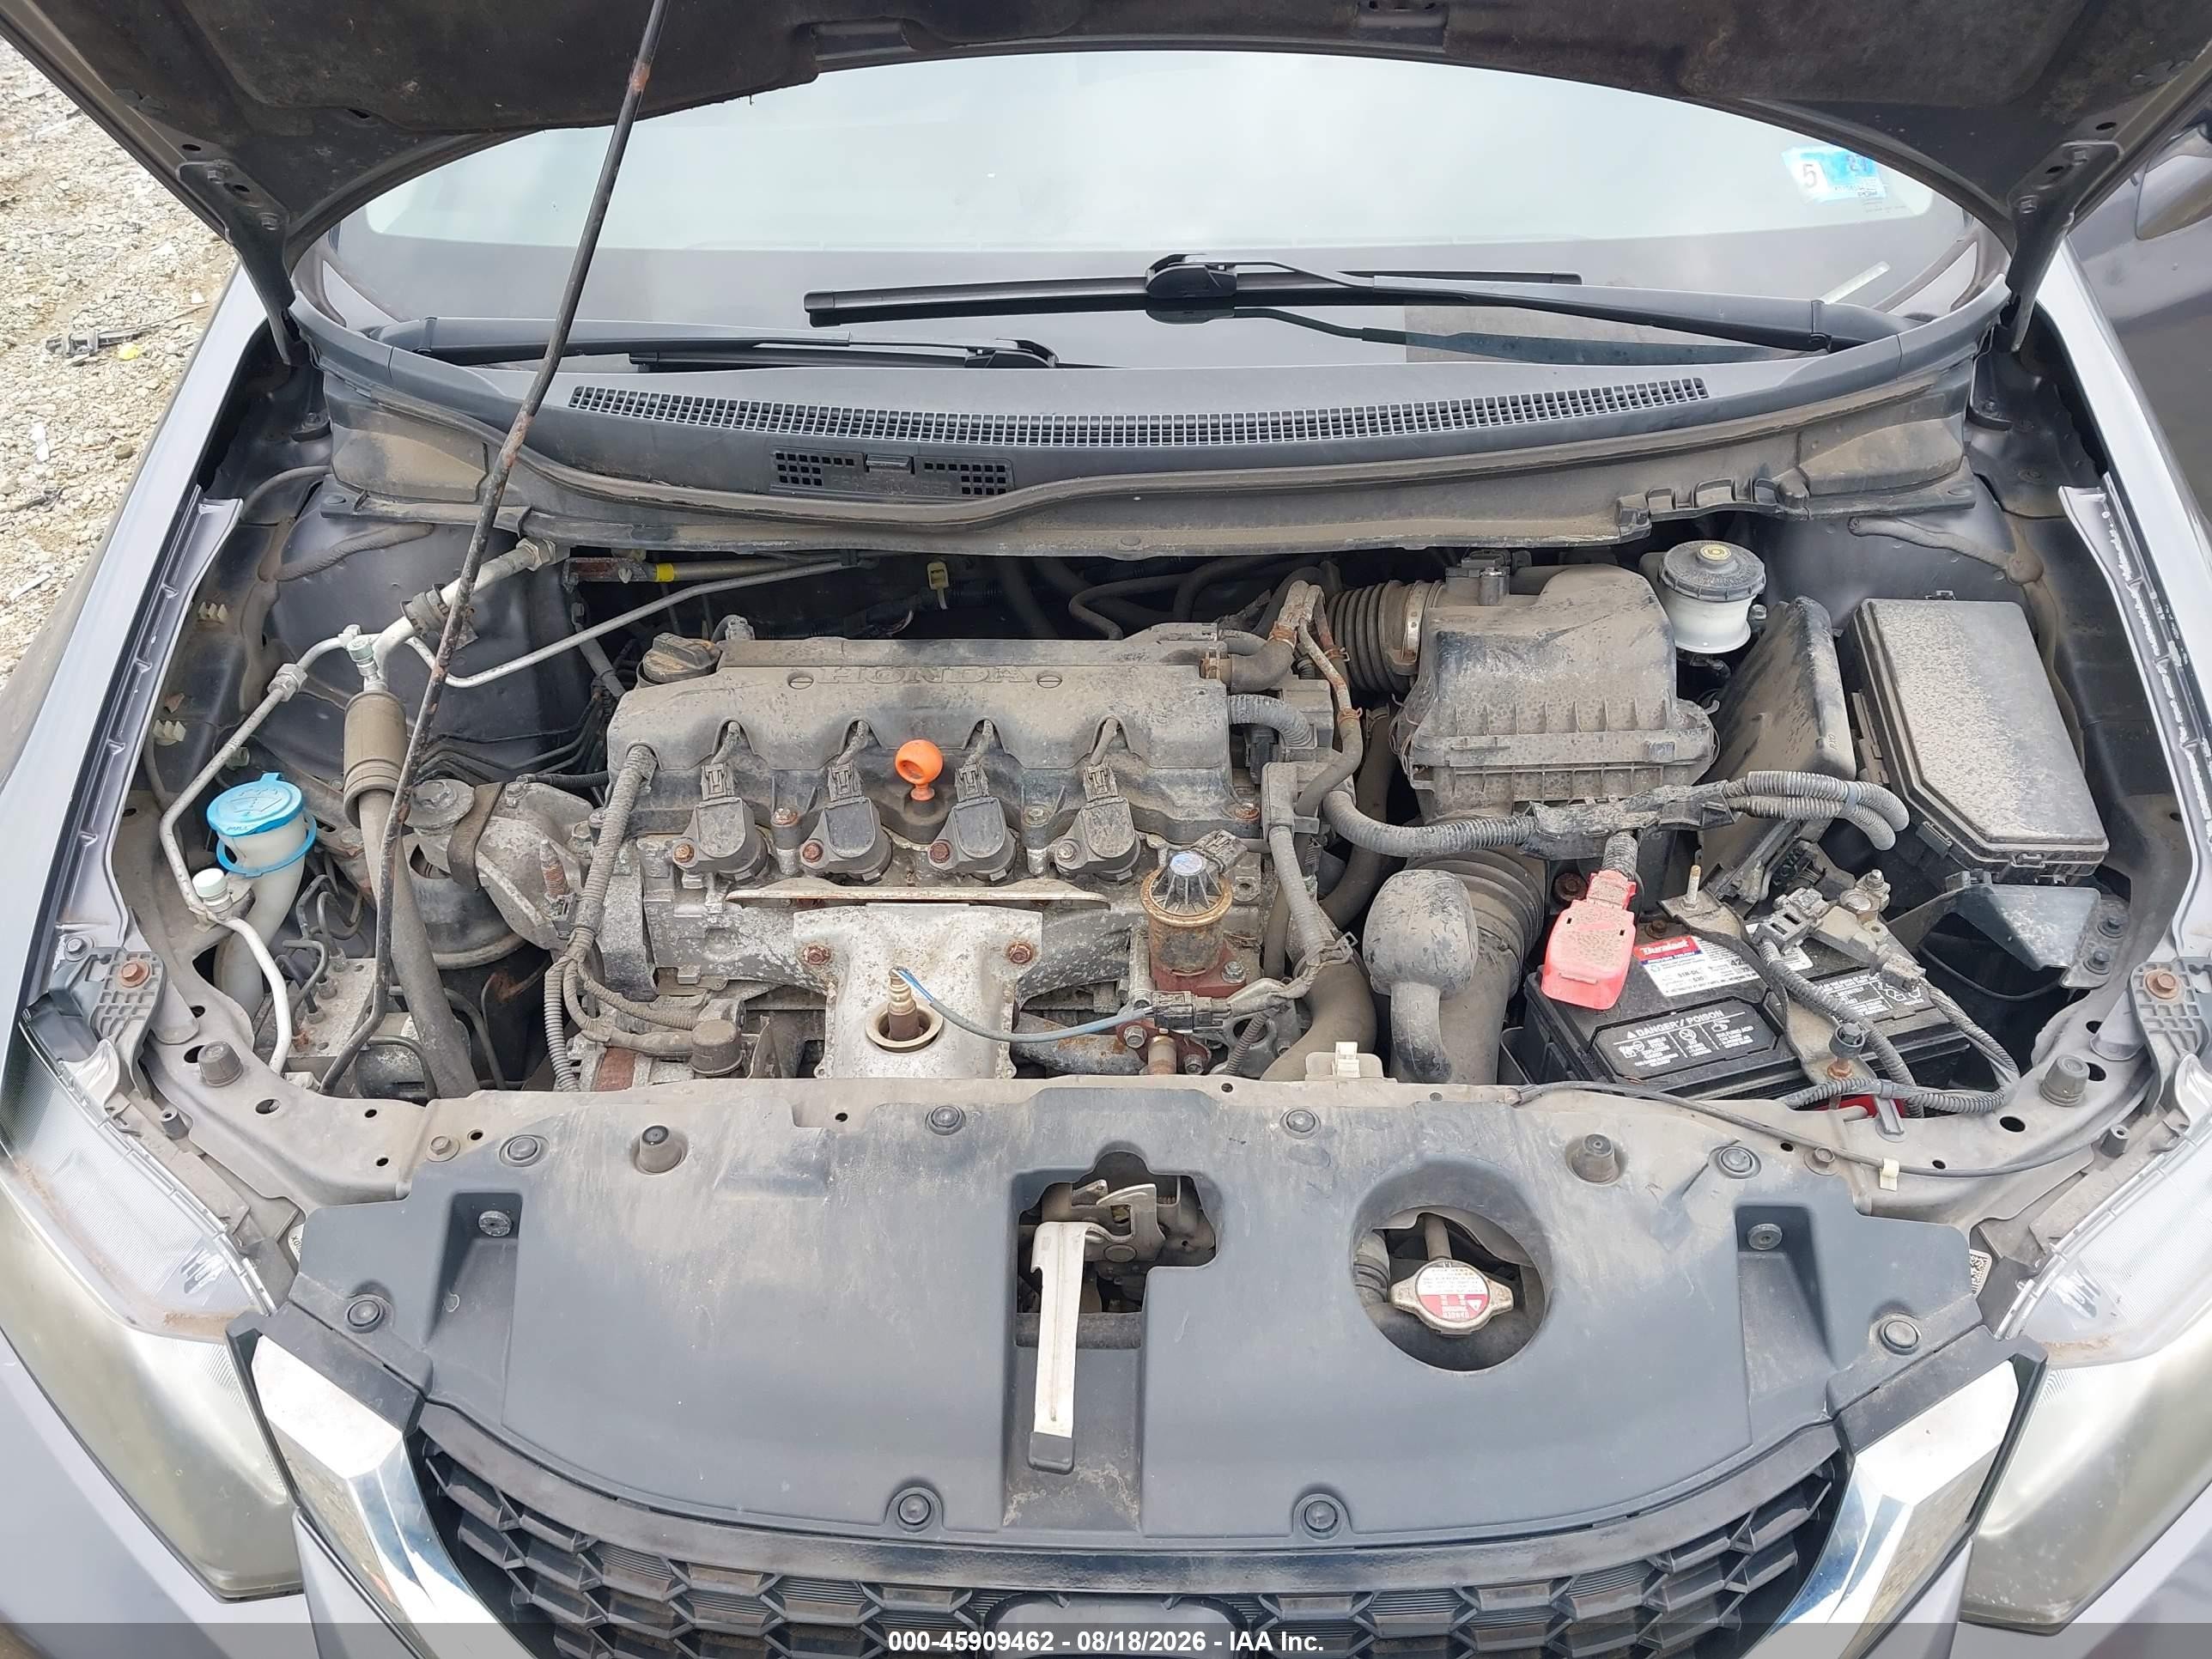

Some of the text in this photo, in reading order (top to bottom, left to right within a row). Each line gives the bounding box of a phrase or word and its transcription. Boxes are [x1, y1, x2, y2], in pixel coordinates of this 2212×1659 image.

[1802, 163, 1818, 189] 5
[817, 666, 1031, 684] HONDA
[1686, 1010, 1725, 1024] POISON
